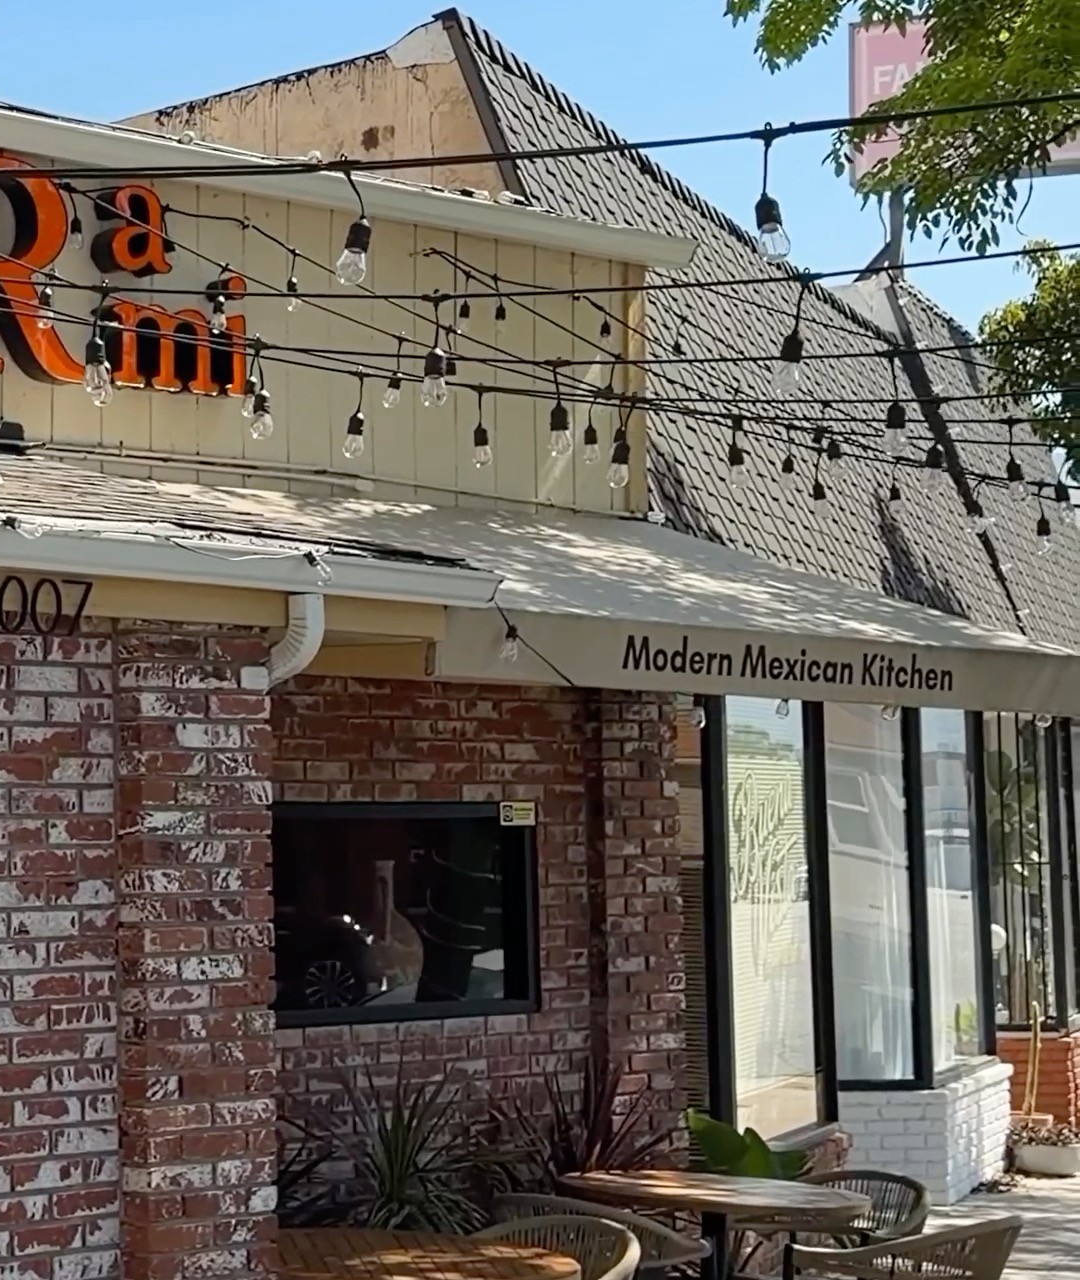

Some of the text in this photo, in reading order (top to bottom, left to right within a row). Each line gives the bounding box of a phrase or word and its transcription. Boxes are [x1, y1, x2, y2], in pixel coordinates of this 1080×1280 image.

[91, 185, 172, 278] a
[92, 275, 247, 398] mi
[621, 634, 954, 692] Modern Mexican Kitchen
